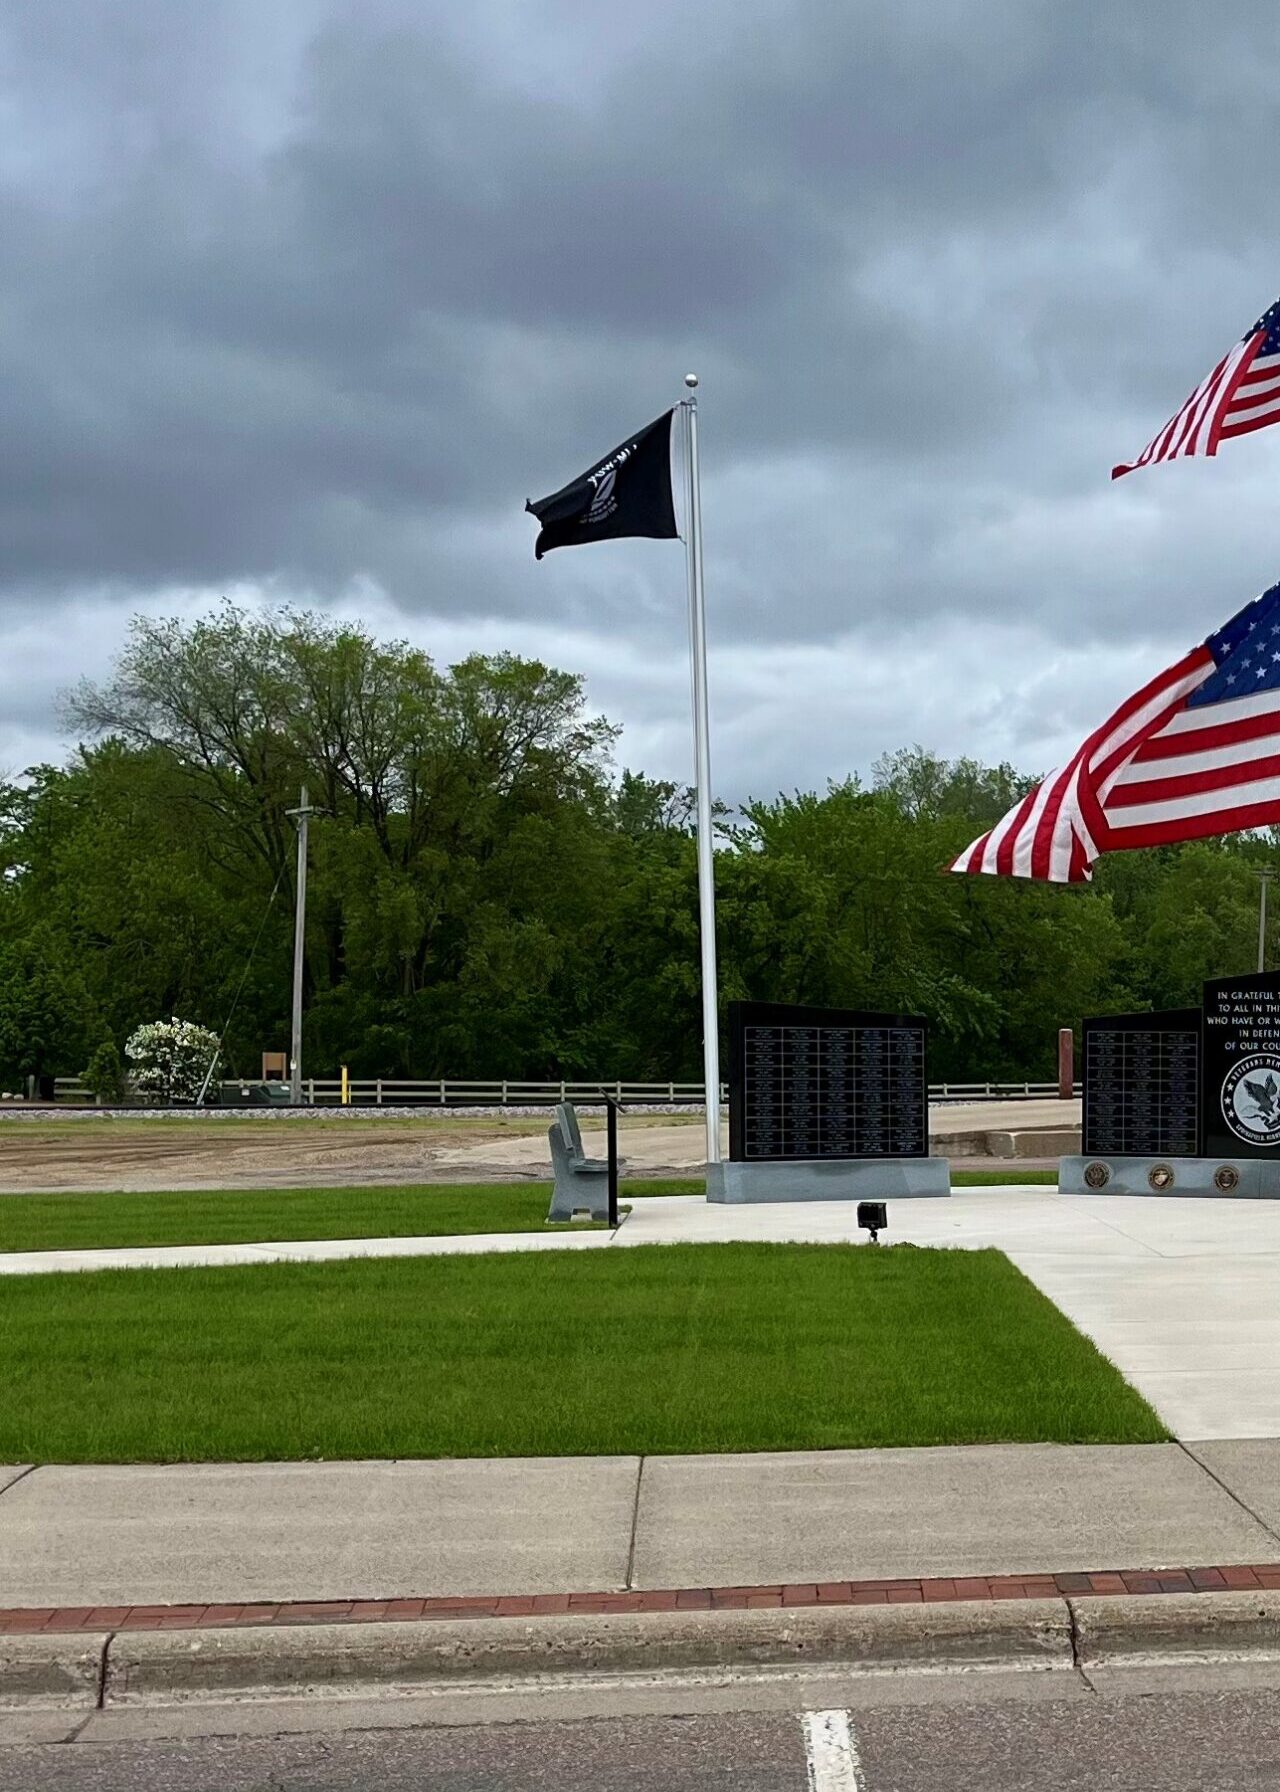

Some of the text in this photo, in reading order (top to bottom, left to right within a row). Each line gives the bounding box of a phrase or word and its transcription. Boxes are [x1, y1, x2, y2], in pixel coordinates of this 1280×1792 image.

[1217, 991, 1228, 1000] IN
[1230, 991, 1274, 1000] GRATEFUL
[1218, 1004, 1231, 1013] TO
[1233, 1004, 1249, 1013] ALL
[1252, 1004, 1262, 1013] IN
[1206, 1016, 1228, 1025] WHO
[1231, 1016, 1254, 1025] HAVE
[1257, 1016, 1271, 1025] OR
[1239, 1029, 1249, 1038] IN
[1224, 1042, 1236, 1051] OF
[1239, 1042, 1259, 1051] OUR
